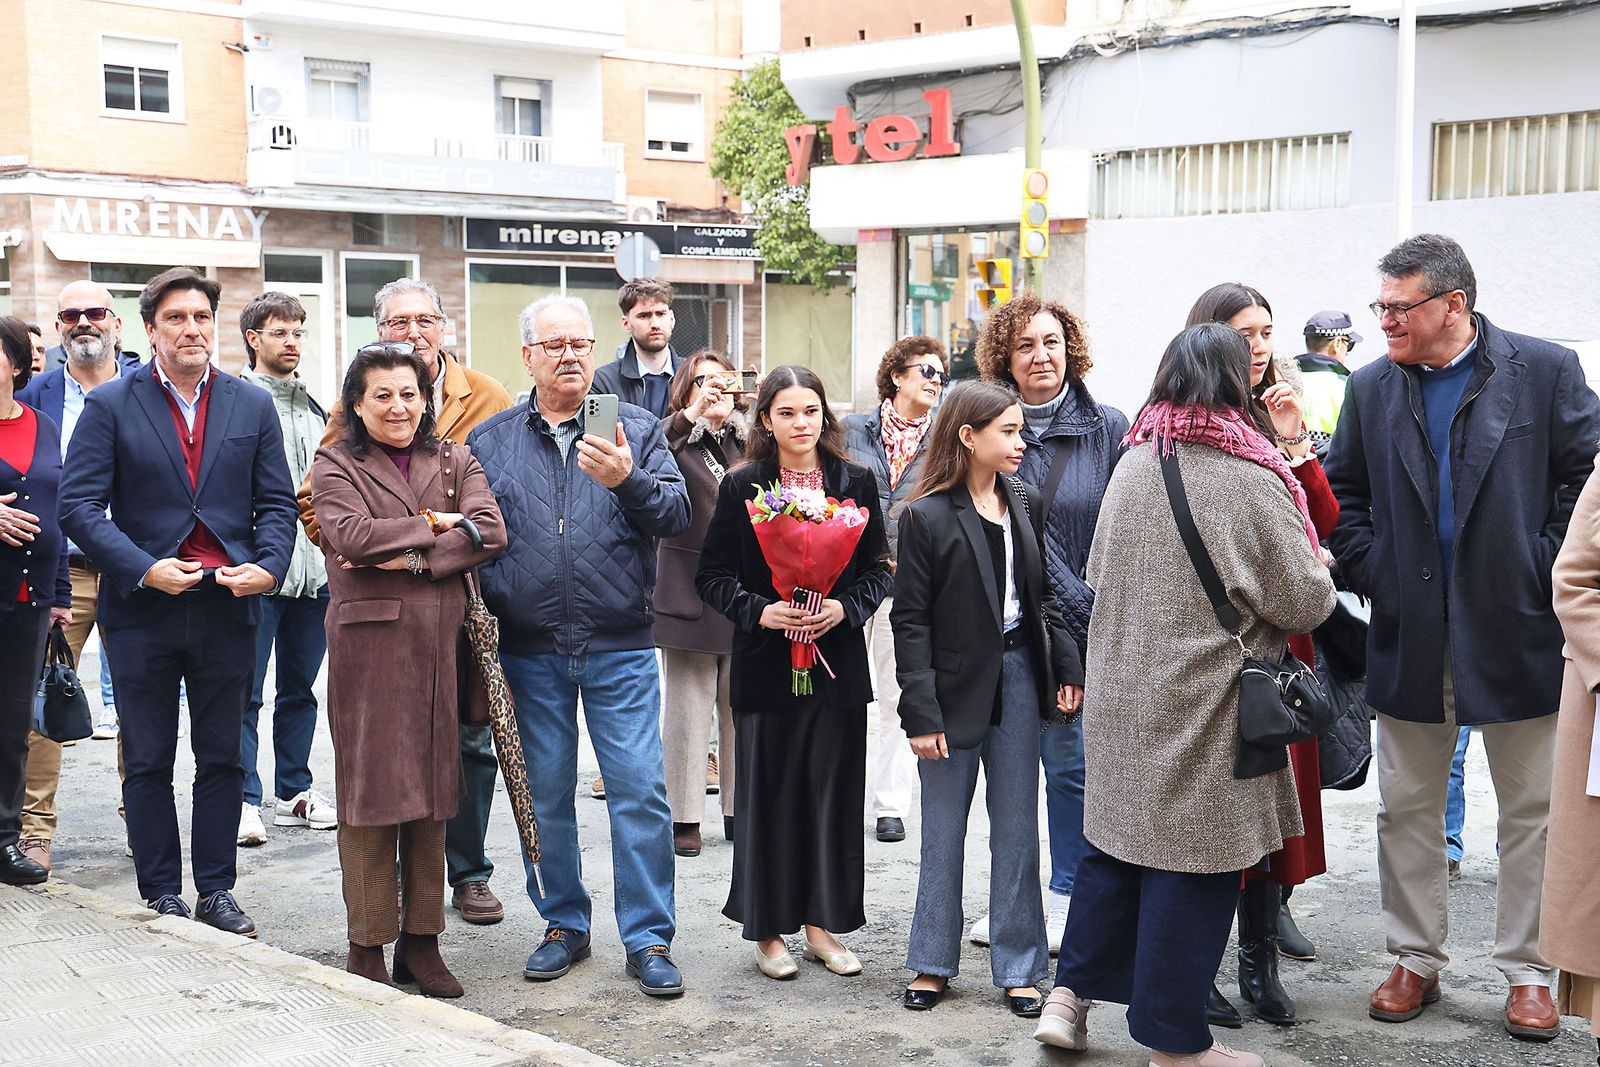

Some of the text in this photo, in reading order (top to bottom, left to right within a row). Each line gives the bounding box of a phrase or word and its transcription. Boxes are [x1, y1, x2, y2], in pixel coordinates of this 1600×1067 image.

[784, 88, 960, 187] ytel
[51, 197, 269, 242] MIRENAY
[694, 228, 747, 238] CALZADOS
[716, 238, 725, 246] Y
[681, 246, 761, 256] COMPLEMENTOS
